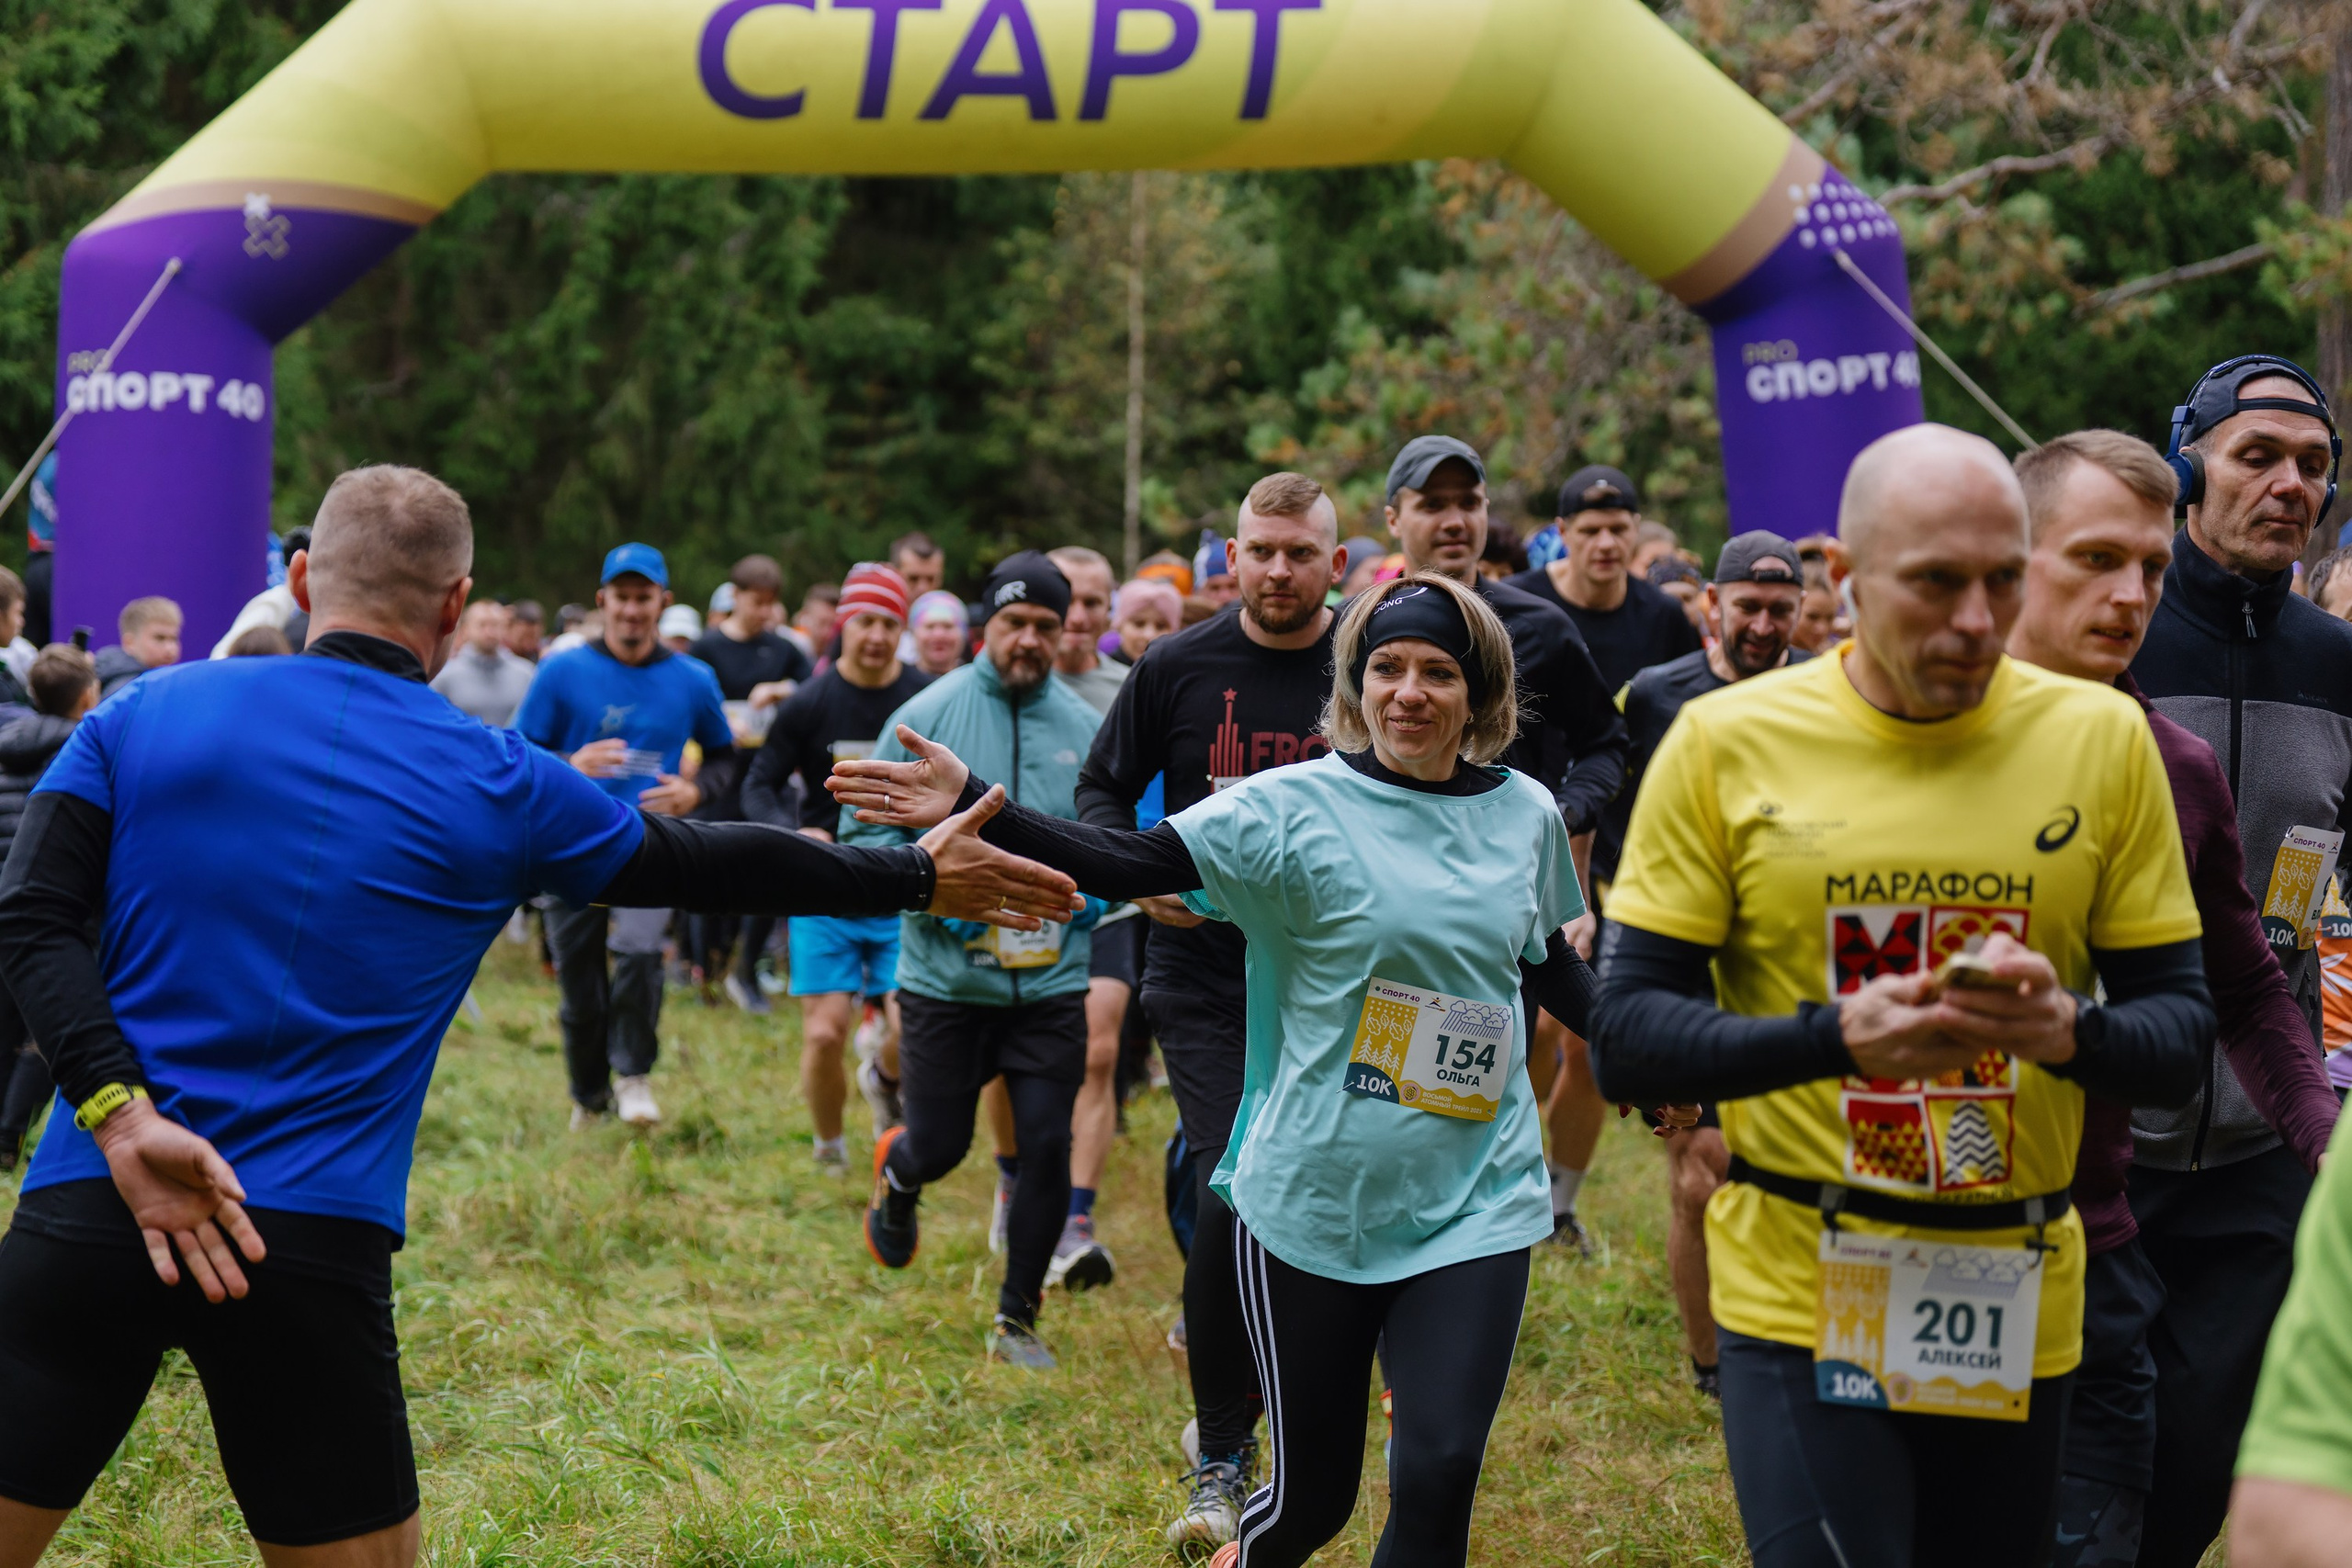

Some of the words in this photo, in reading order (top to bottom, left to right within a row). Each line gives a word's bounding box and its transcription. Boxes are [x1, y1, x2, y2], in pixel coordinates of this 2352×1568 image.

[695, 0, 1323, 121] СТАРТ
[1746, 352, 1891, 403] СПОРТ
[66, 371, 215, 413] СПОРТ
[216, 378, 266, 423] 40
[2293, 837, 2317, 847] СПОРТ
[1826, 872, 2034, 904] МАРАФОН
[2332, 922, 2352, 937] 10
[1382, 988, 1409, 1000] СПОРТ
[1409, 995, 1420, 1003] 40
[1434, 1033, 1498, 1075] 154
[1436, 1068, 1480, 1088] ОЛЬГА
[1420, 1098, 1452, 1109] АТОМНЫЙ
[1422, 1091, 1453, 1102] ВОСЬМОЙ
[1913, 1298, 2004, 1349] 201
[1917, 1348, 2002, 1371] АЛЕКСЕЙ
